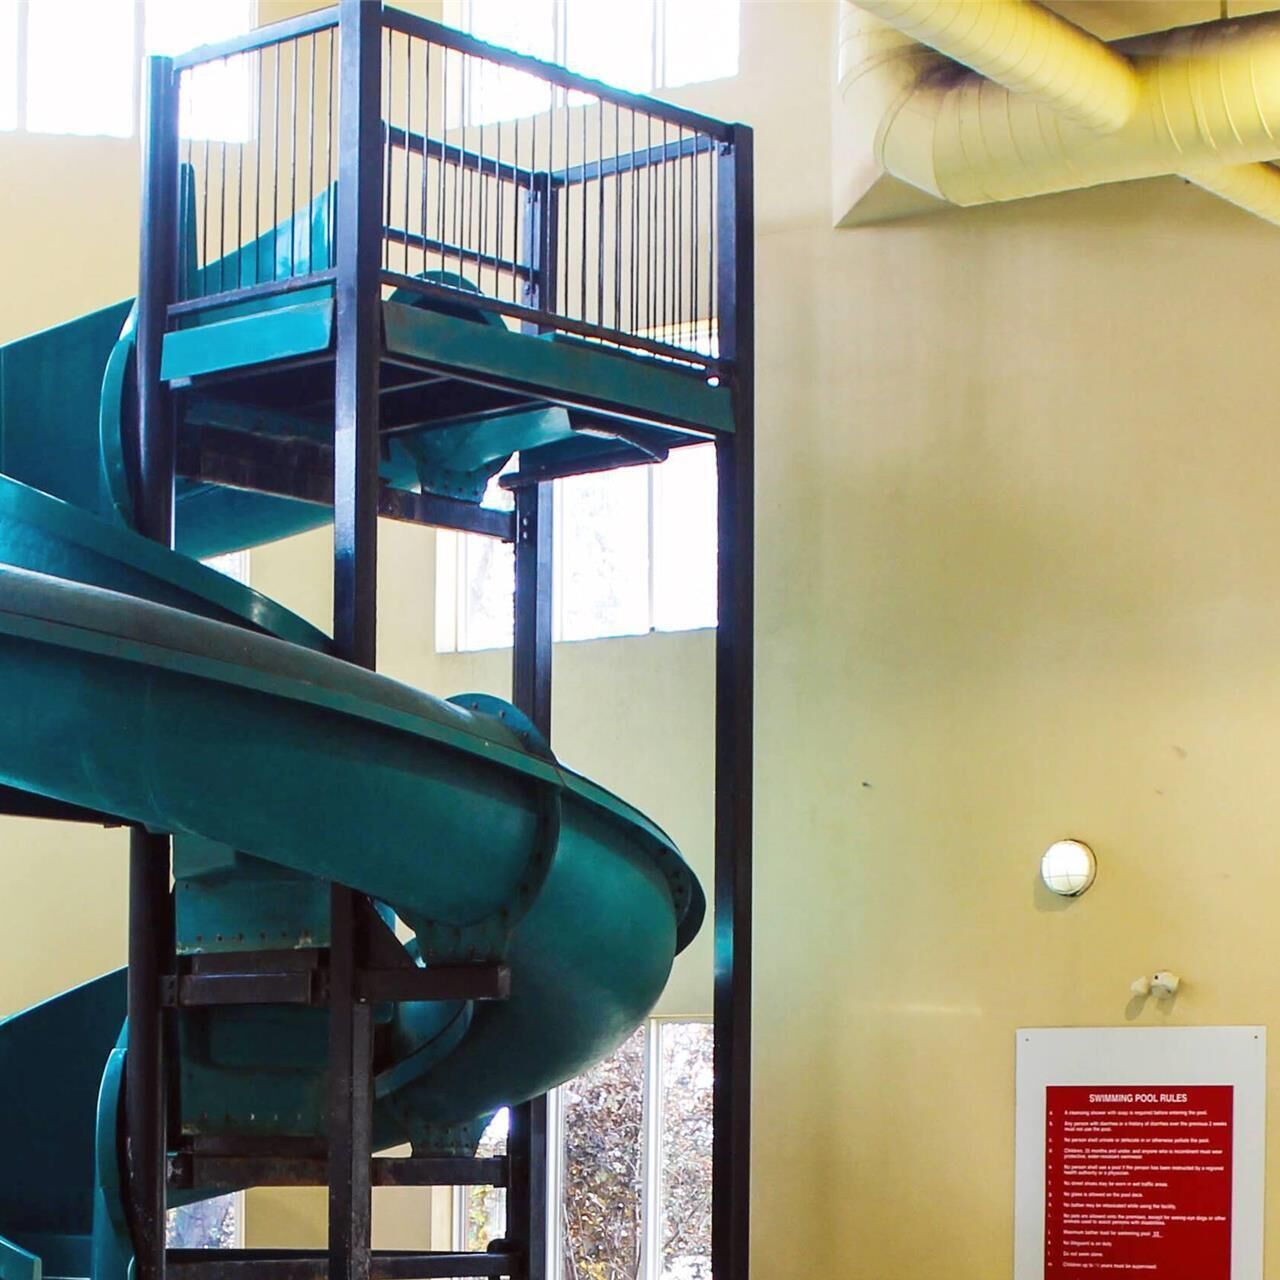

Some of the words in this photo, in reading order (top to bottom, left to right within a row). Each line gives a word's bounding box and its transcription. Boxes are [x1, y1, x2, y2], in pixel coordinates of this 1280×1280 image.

[1088, 1093, 1134, 1103] SWIMMING
[1135, 1093, 1158, 1103] POOL
[1159, 1093, 1188, 1103] RULES
